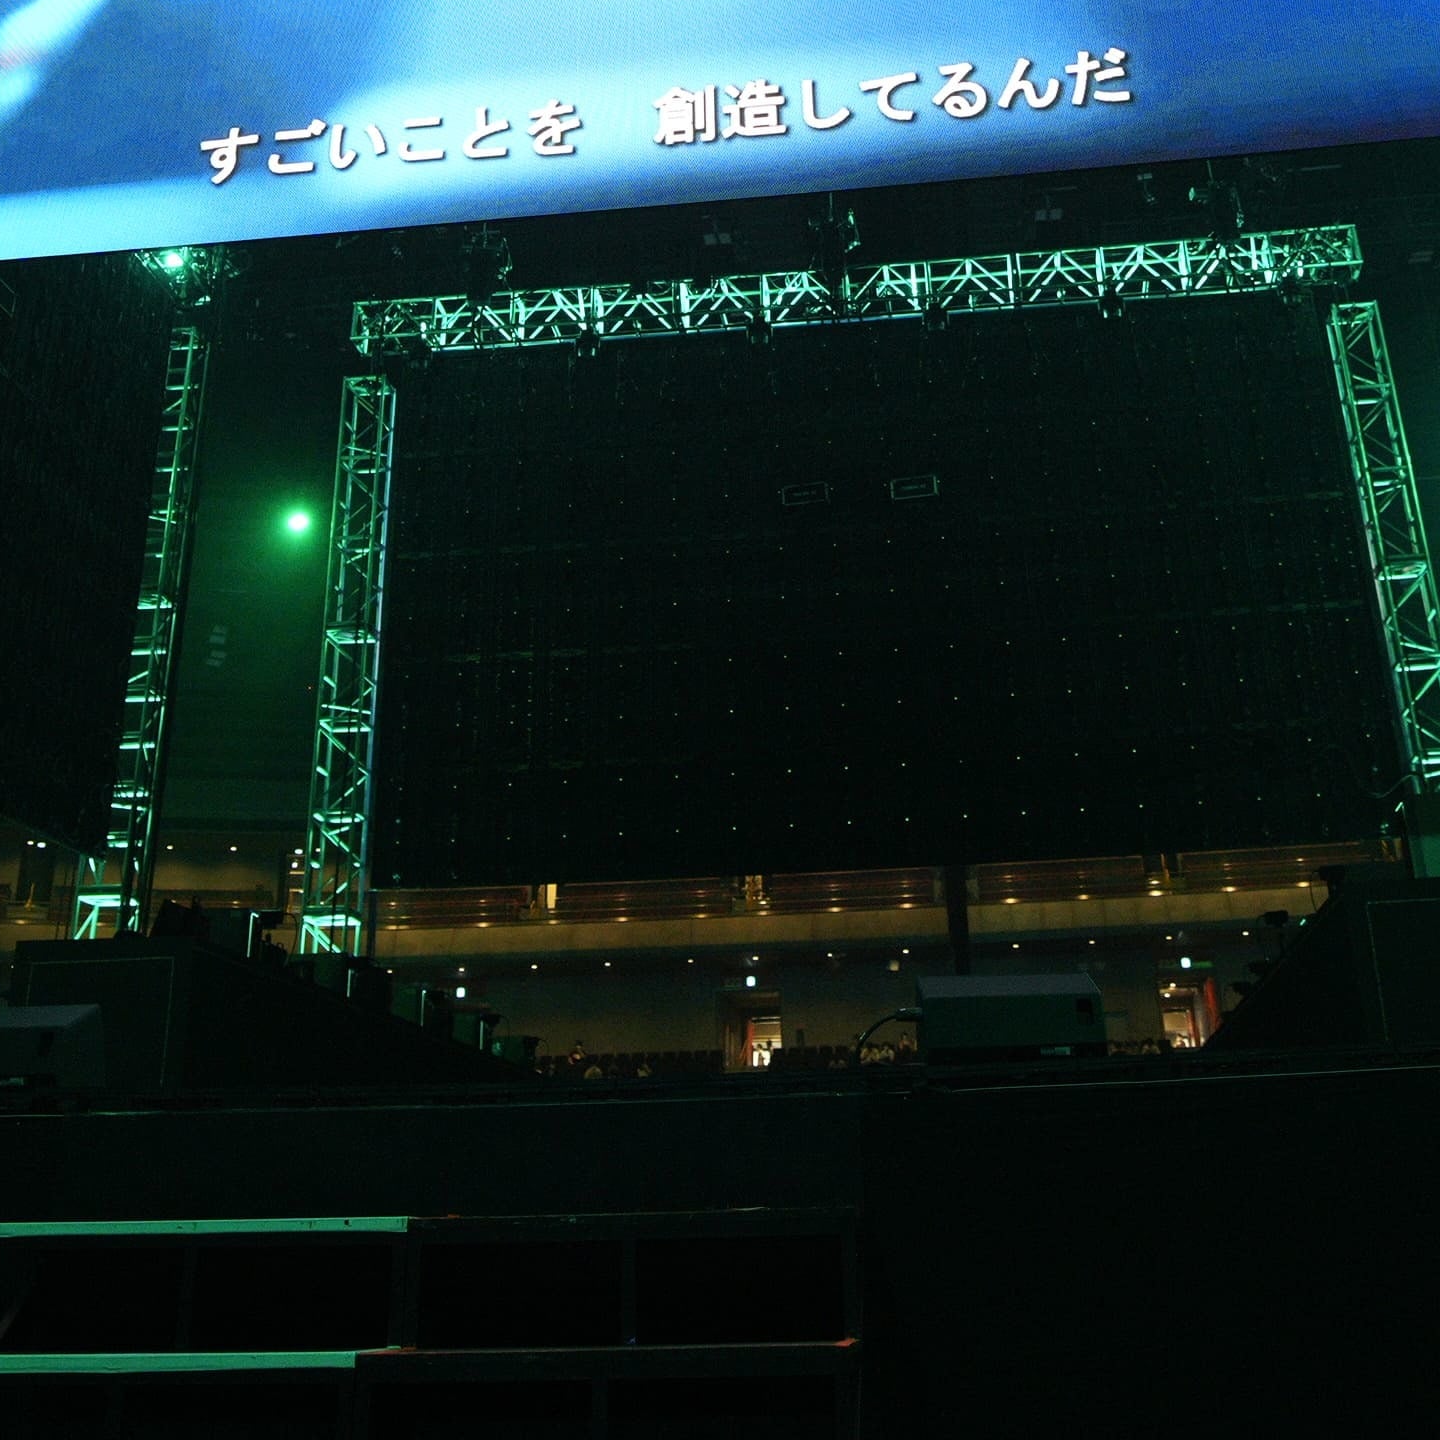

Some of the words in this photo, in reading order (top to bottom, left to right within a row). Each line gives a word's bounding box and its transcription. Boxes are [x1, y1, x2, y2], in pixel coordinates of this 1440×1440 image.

[200, 100, 581, 185] すごいことを
[652, 47, 1131, 145] 創造してるんだ
